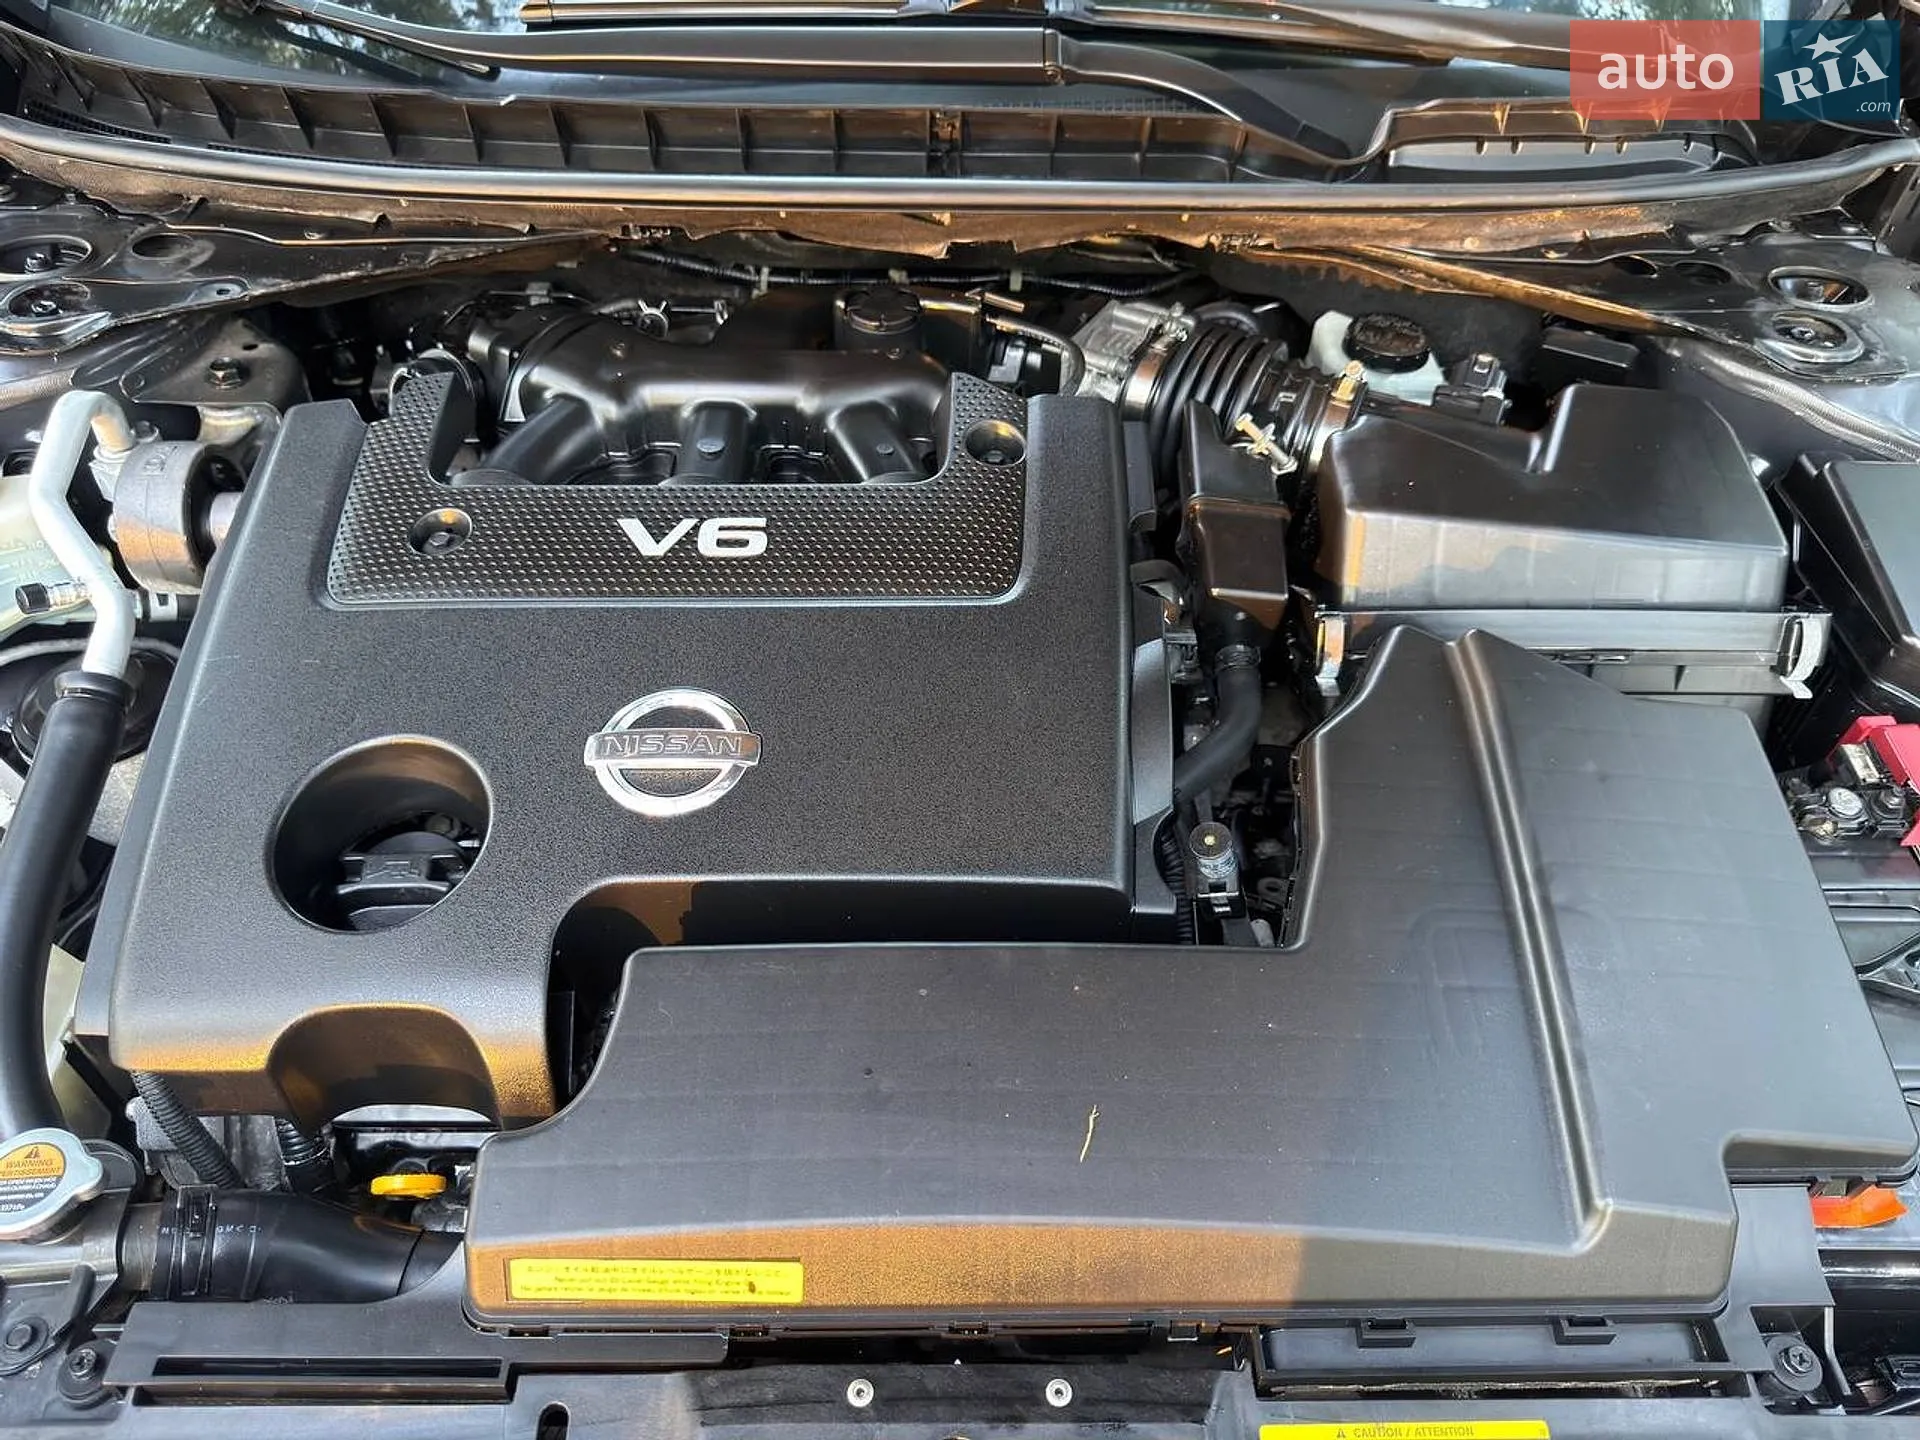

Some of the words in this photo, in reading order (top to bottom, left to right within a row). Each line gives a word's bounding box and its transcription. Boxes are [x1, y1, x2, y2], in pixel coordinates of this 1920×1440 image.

[617, 517, 768, 558] V6
[603, 733, 742, 756] NISSAN
[1354, 1427, 1401, 1438] CAUTION
[1414, 1426, 1475, 1437] ATTENTION
